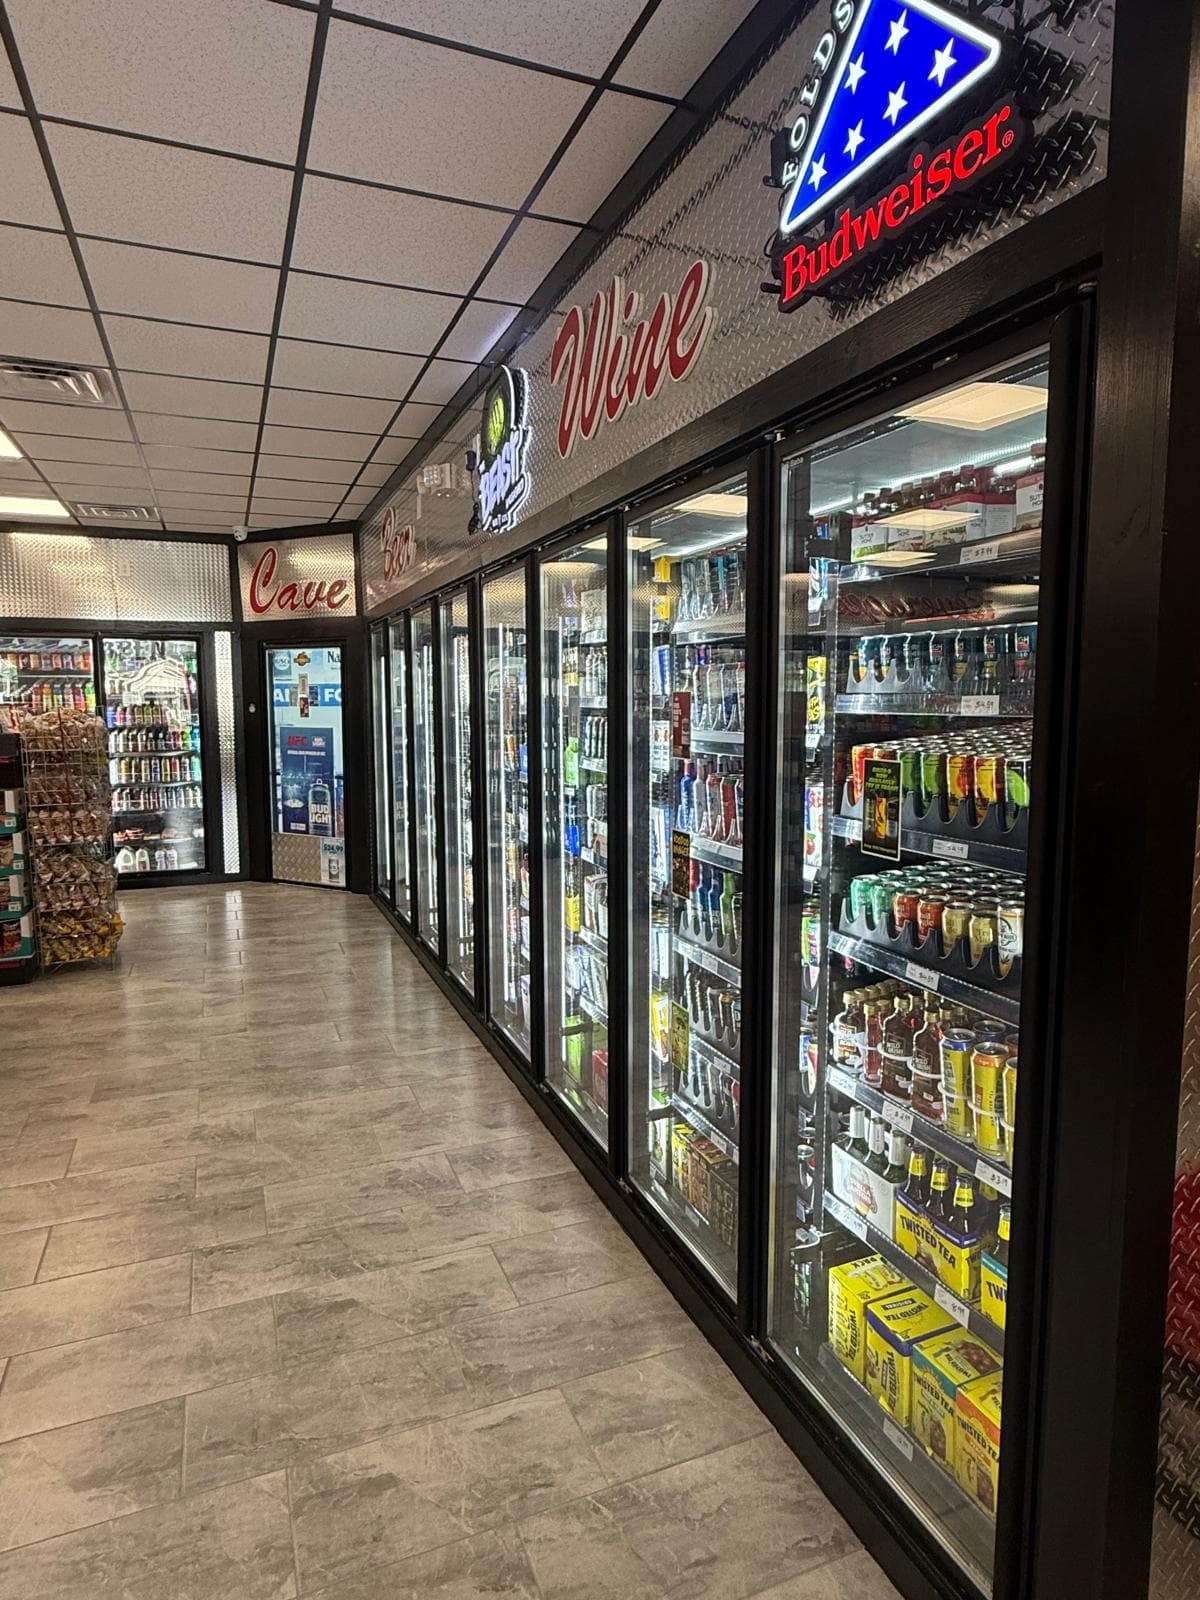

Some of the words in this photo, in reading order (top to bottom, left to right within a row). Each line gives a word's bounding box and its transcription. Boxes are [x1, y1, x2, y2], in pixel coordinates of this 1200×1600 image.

[782, 0, 855, 190] FOLDS
[782, 104, 1012, 304] Budweiser
[550, 260, 714, 460] Wine
[249, 547, 350, 614] Cave
[311, 803, 330, 814] BUD
[900, 1214, 937, 1248] TWISTED
[938, 1243, 956, 1269] TEA
[848, 1309, 858, 1348] TWISTED
[886, 1350, 898, 1395] TWISTED
[912, 1373, 941, 1402] TWISTED
[940, 1394, 955, 1417] TEA
[956, 1415, 987, 1449] TWISTED
